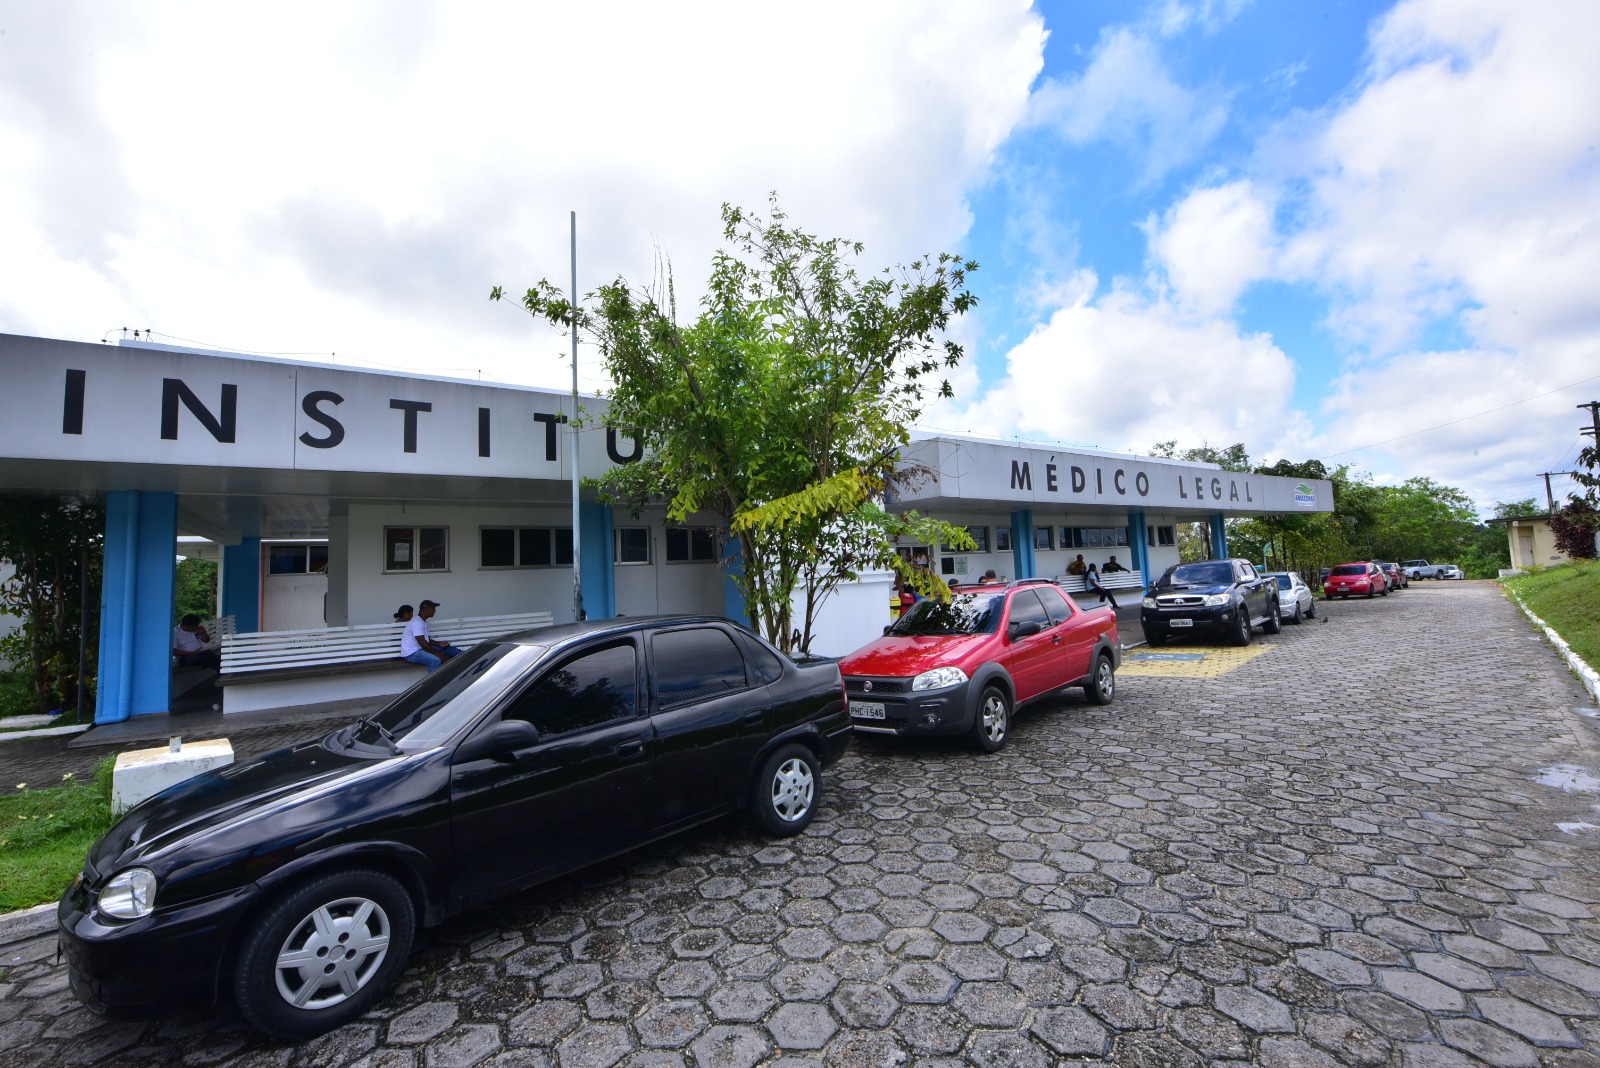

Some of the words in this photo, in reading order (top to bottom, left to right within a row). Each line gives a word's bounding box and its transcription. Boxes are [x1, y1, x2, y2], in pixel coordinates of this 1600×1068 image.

[62, 368, 645, 465] INSTITU
[1010, 455, 1150, 497] MÉDICO
[1178, 475, 1254, 503] LEGAL
